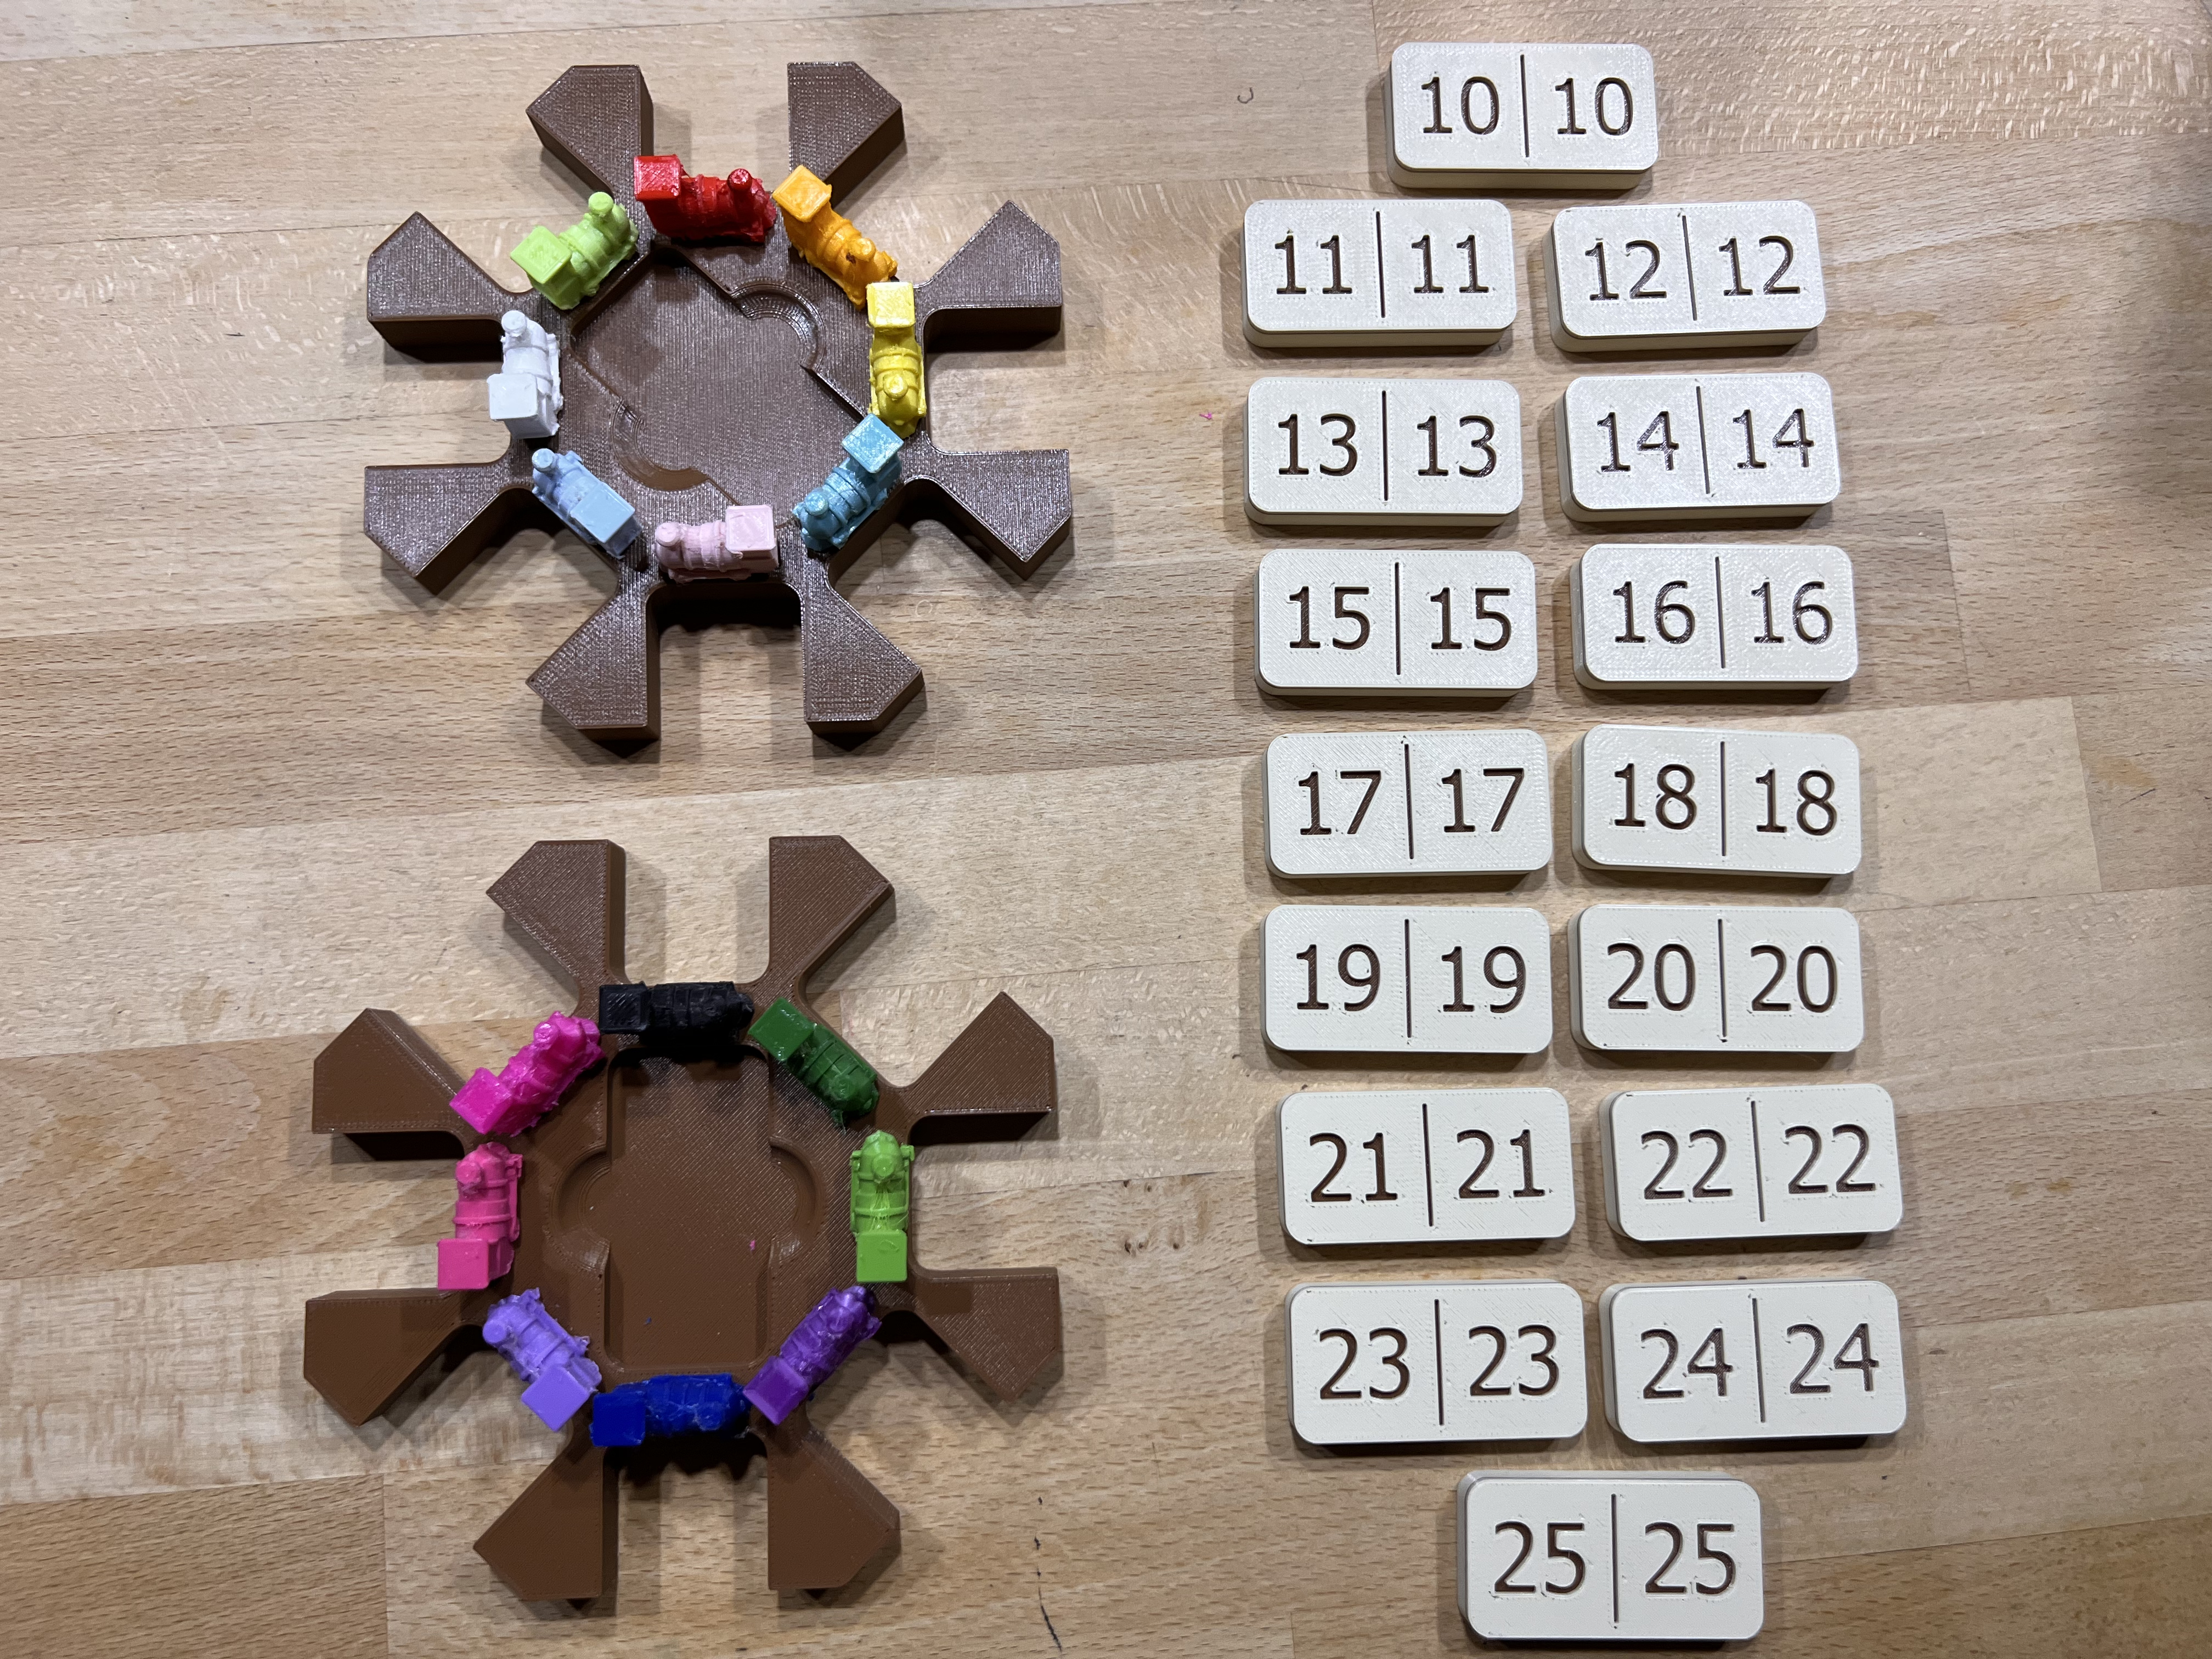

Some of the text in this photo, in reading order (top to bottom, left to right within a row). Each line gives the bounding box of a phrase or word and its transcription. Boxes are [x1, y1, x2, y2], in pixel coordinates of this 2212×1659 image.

[1420, 76, 1634, 137] 10 10
[1273, 233, 1489, 296] 11 11
[1584, 235, 1802, 302] 12 12
[1277, 413, 1497, 478] 13 13
[1596, 407, 1815, 473] 14 14
[1288, 585, 1513, 652] 15 15
[1612, 579, 1833, 646] 16 16
[1297, 767, 1525, 836] 17 17
[1613, 762, 1838, 837] 18 18
[1295, 943, 1527, 1014] 19 19
[1606, 942, 1838, 1014] 20 20
[1308, 1128, 1546, 1203] 21 21
[1640, 1123, 1876, 1200] 22 22
[1319, 1324, 1560, 1401] 23 23
[1640, 1322, 1880, 1400] 24 24
[1493, 1520, 1737, 1596] 25 25
